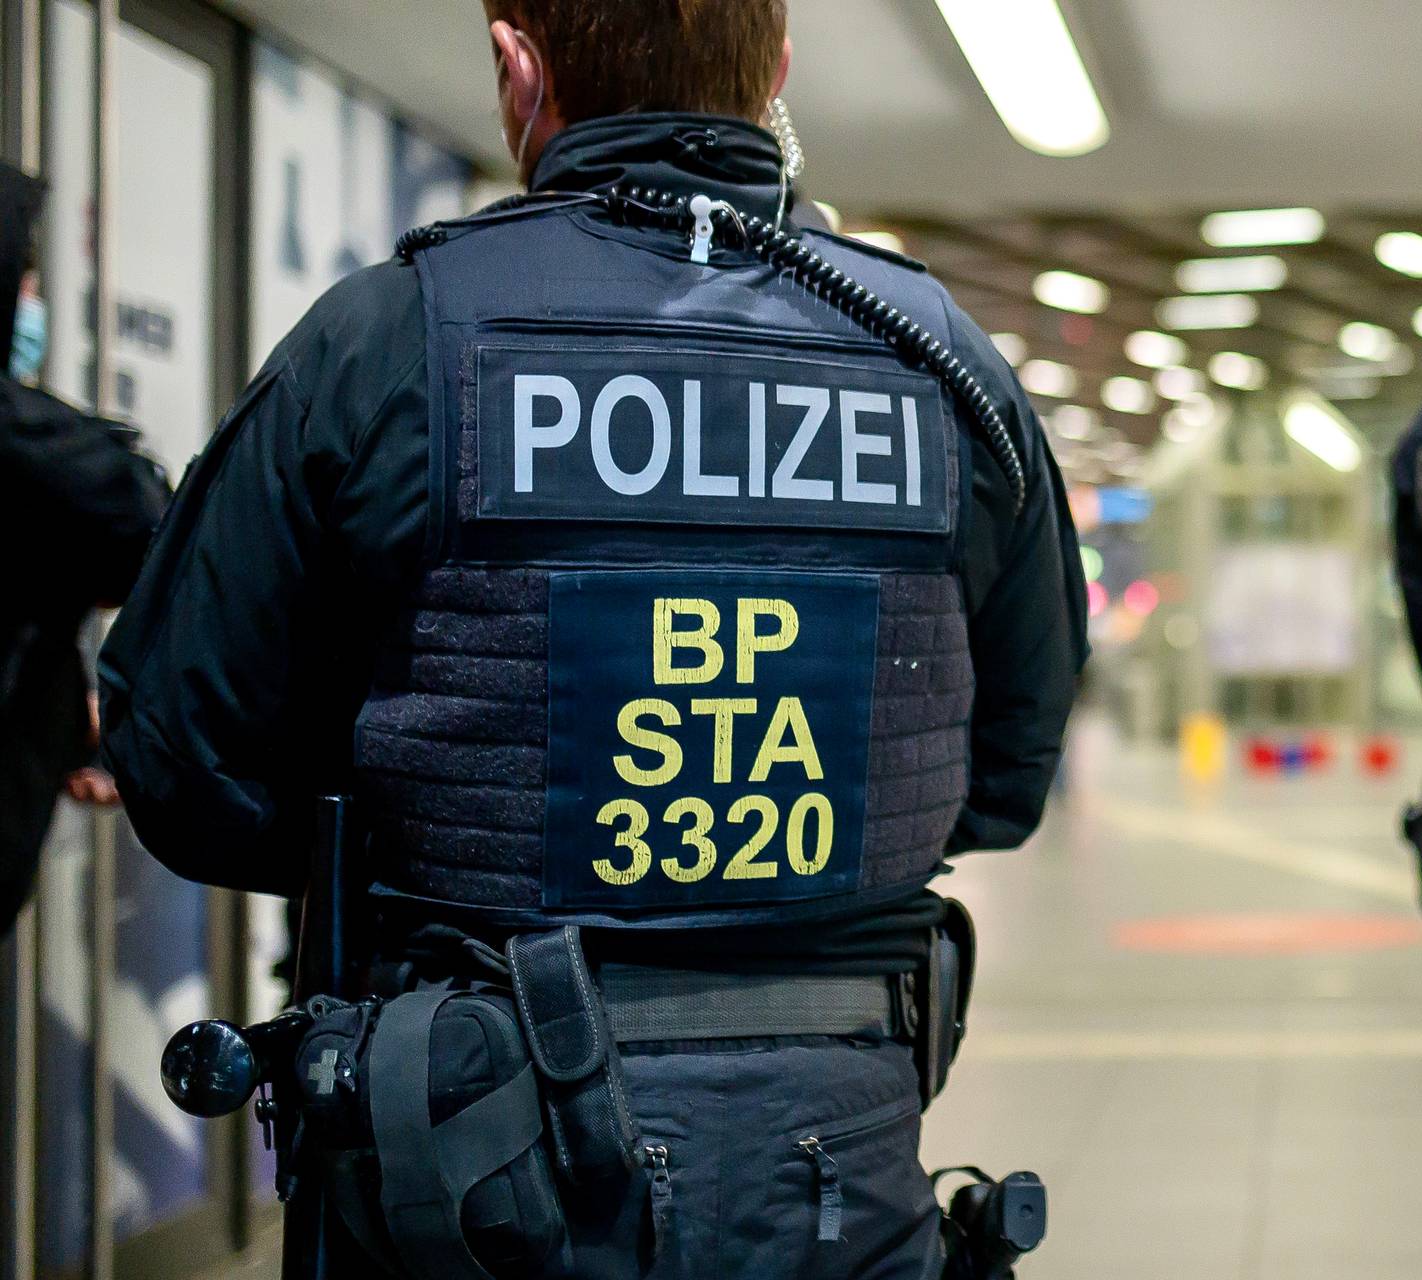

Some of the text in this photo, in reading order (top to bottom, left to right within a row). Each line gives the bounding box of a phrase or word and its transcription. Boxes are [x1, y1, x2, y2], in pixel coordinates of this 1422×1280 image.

[514, 375, 922, 505] POLIZEI
[652, 598, 800, 685] BP
[613, 696, 824, 786] STA
[592, 793, 834, 885] 3320
